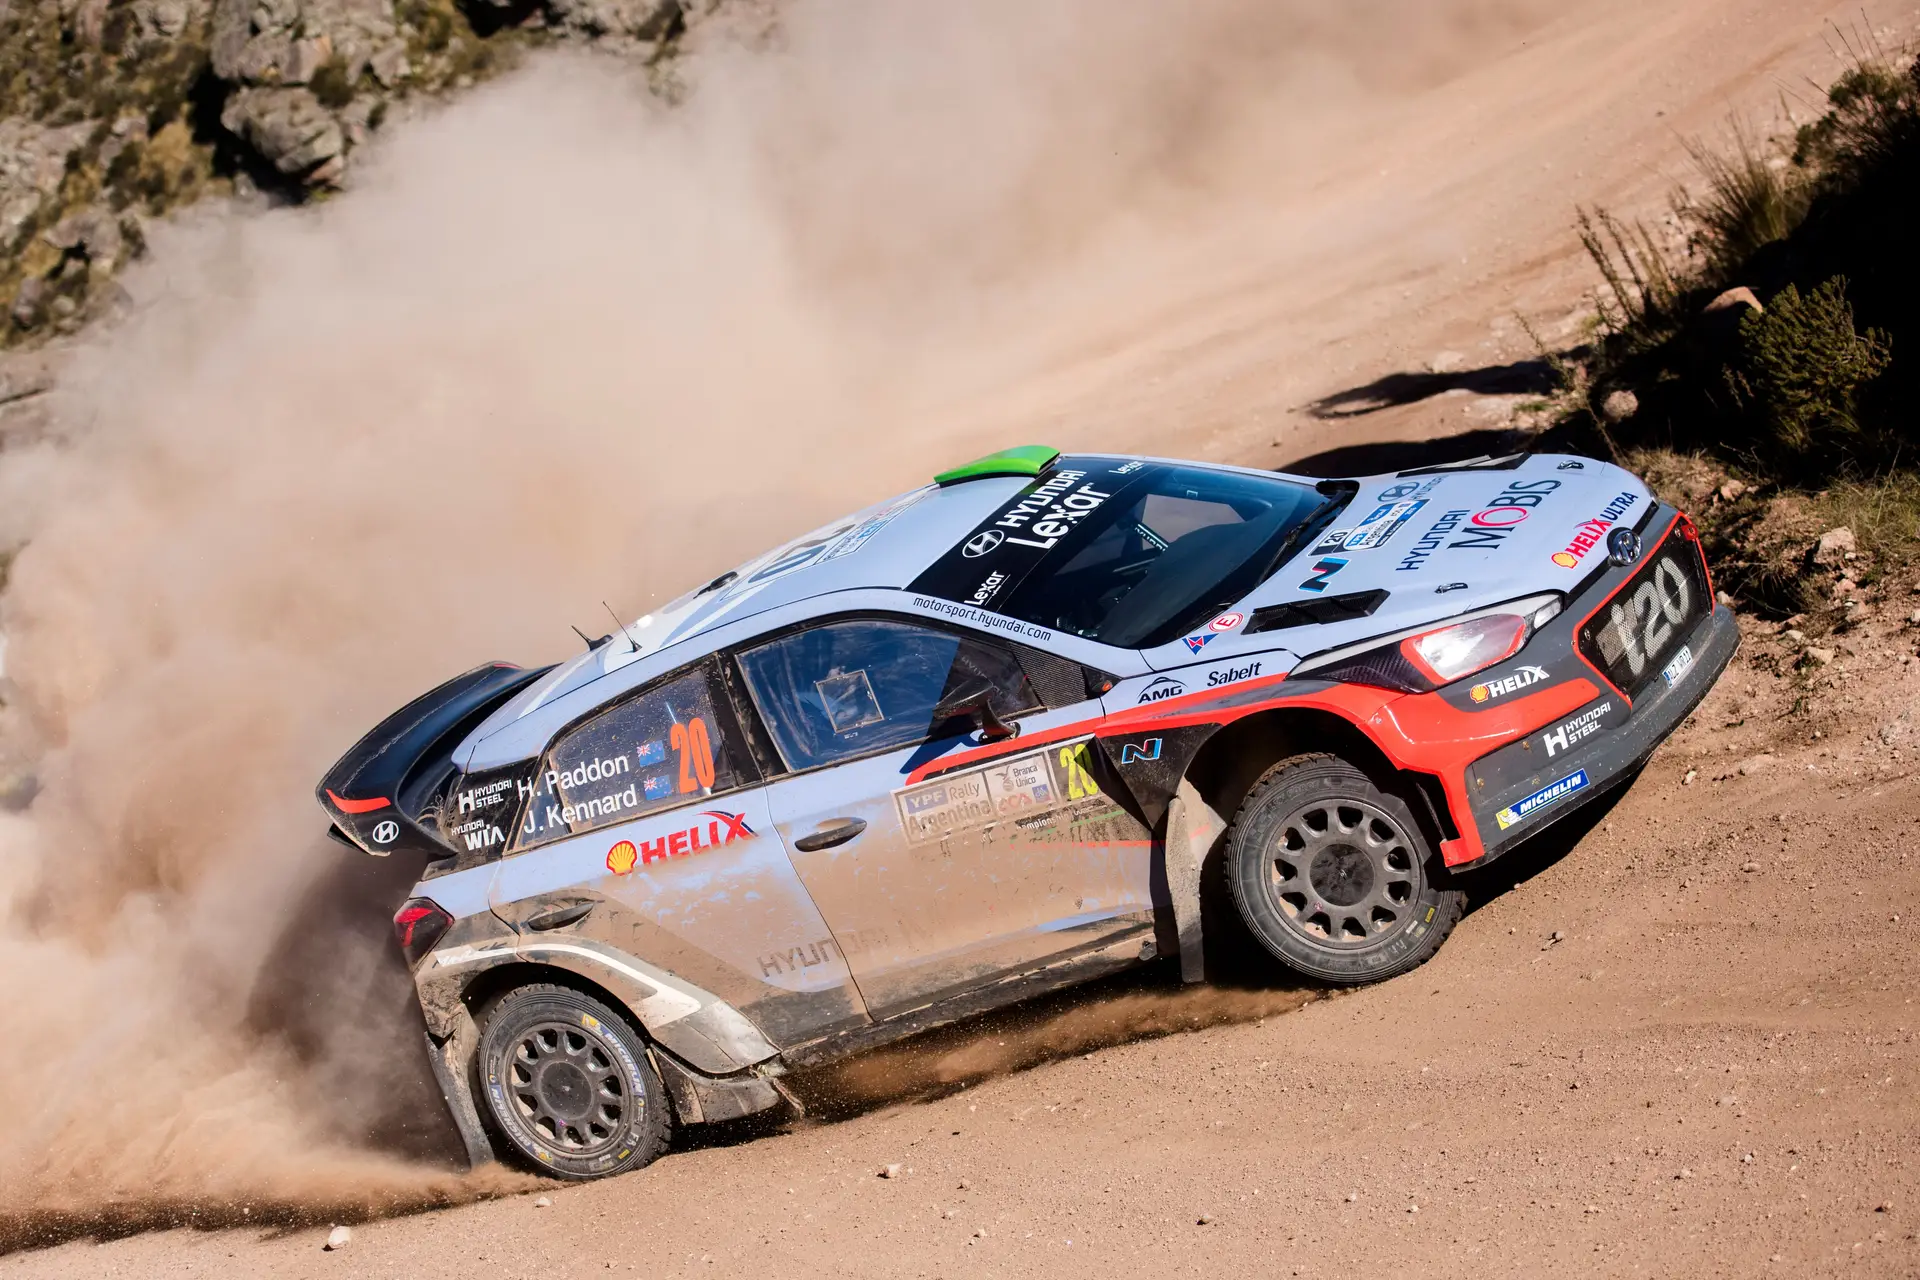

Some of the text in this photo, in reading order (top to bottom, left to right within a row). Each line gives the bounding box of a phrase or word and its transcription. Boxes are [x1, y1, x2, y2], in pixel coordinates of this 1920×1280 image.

[995, 469, 1087, 528] HYUNDAI
[1006, 482, 1110, 549] Lexar
[1448, 479, 1562, 550] MOBIS
[1324, 531, 1348, 544] 20
[1395, 509, 1470, 571] HYUNDAI
[1568, 491, 1639, 559] HELIX ULTRA
[964, 570, 1005, 606] Lexar
[913, 596, 1052, 642] motorsport.hyundai.com
[1610, 556, 1690, 677] i20
[1207, 661, 1262, 687] Sabelt
[1488, 665, 1550, 698] HELIX
[1138, 685, 1183, 704] AMG
[1566, 702, 1611, 733] HYUNDAI
[1569, 720, 1602, 745] STEEL
[670, 717, 716, 795] 20
[1013, 764, 1039, 777] Branca
[474, 778, 513, 799] HYUNDAI
[516, 753, 629, 803] H. Paddon
[908, 782, 980, 809] YPF Rally
[1519, 773, 1583, 814] MICHELIN
[475, 792, 504, 810] STEEL
[523, 783, 638, 835] J. Kennard
[908, 799, 991, 835] Argentina
[451, 819, 485, 836] HYUNDAI
[640, 811, 756, 865] HELIX
